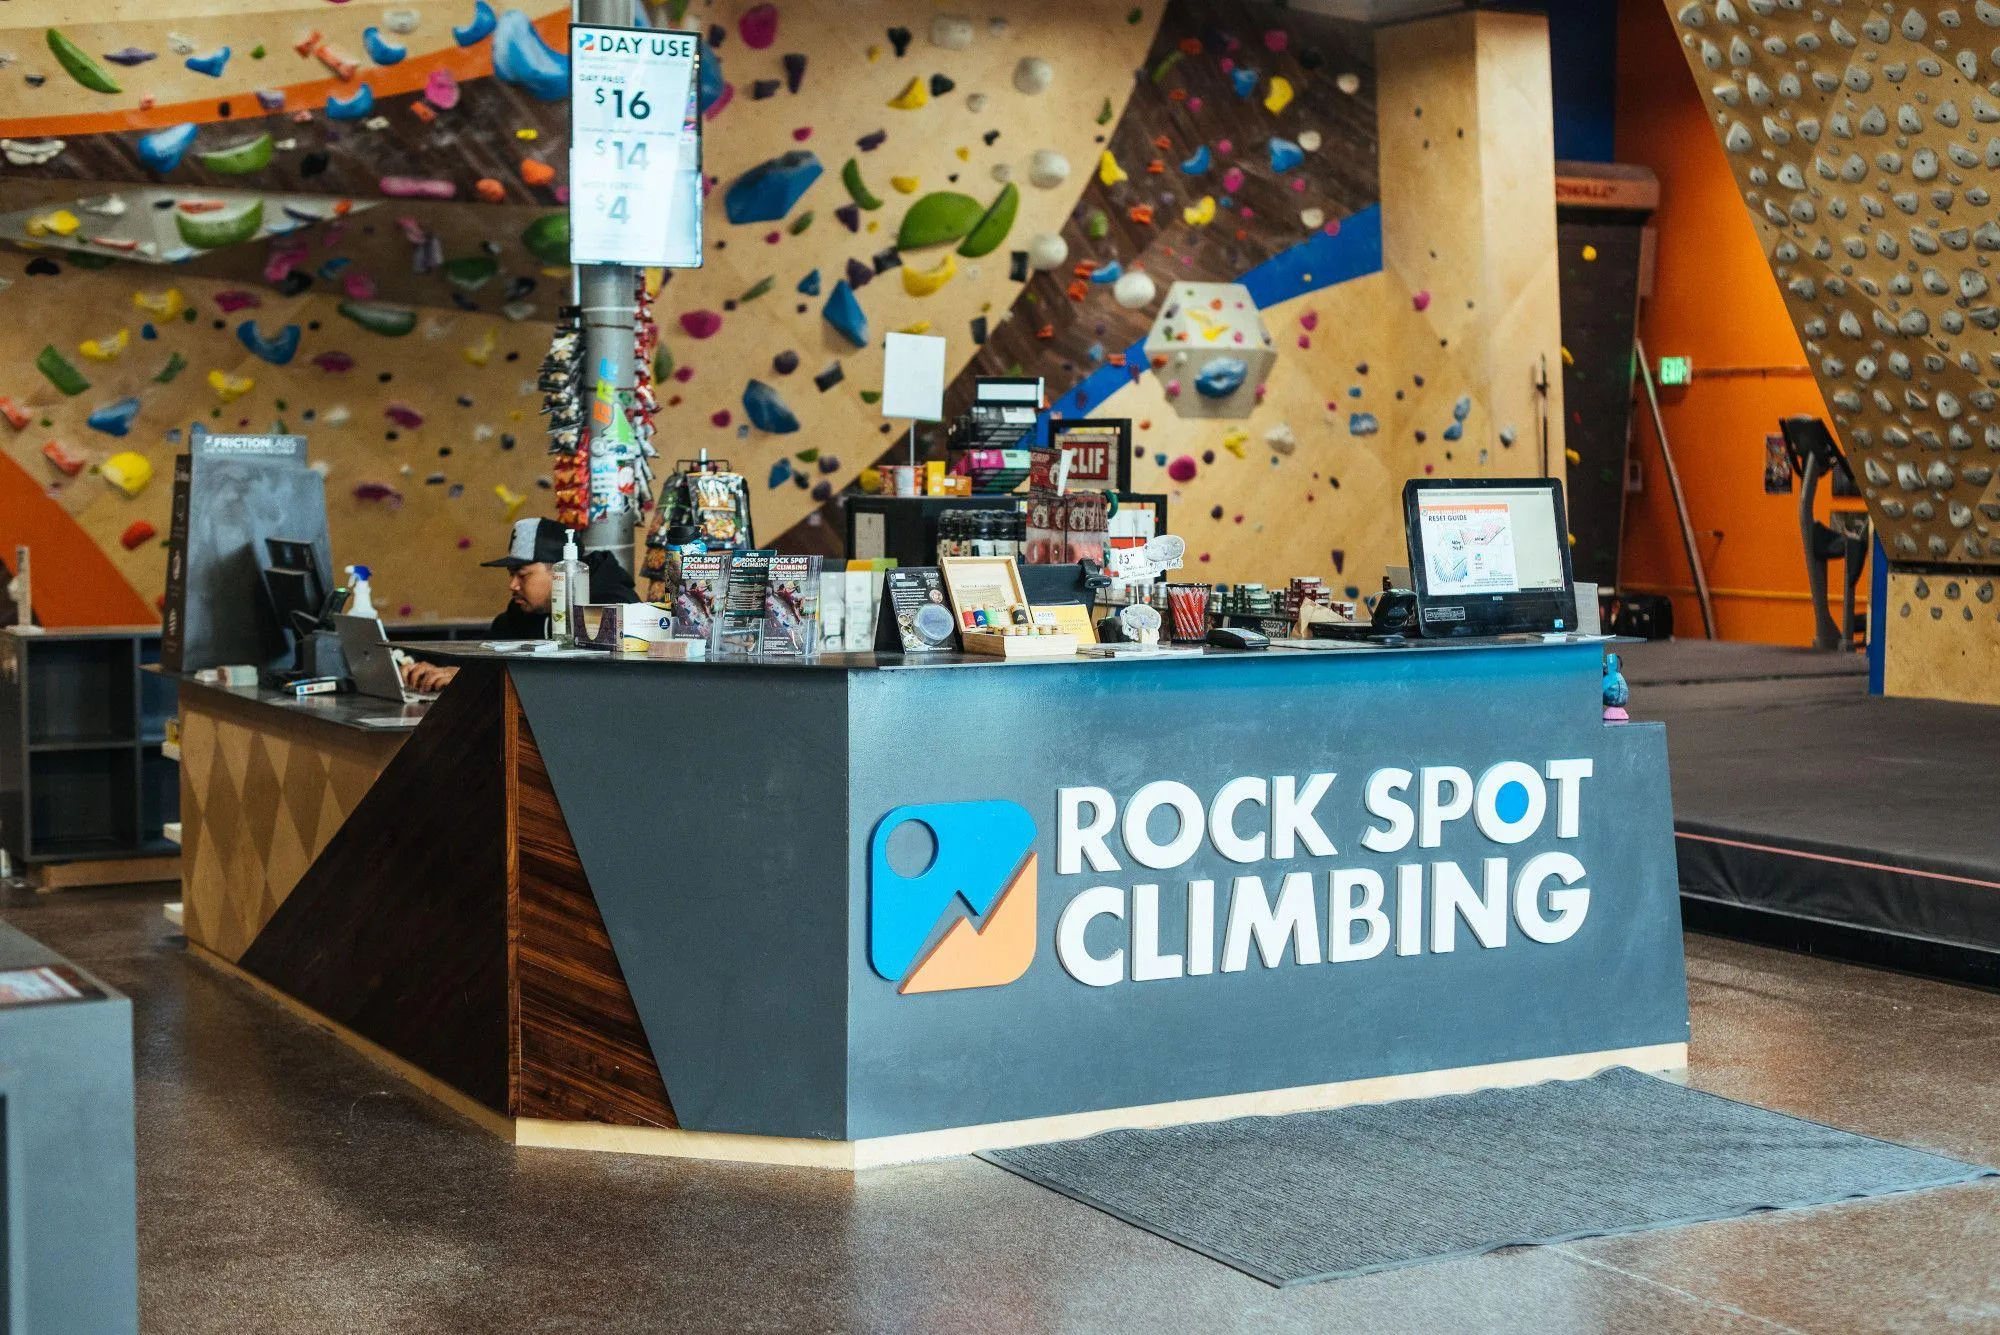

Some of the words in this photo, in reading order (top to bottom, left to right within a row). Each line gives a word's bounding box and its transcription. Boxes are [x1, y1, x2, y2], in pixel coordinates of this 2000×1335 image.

[600, 36, 643, 53] DAY
[651, 39, 690, 57] USE
[1447, 514, 1468, 522] GUIDE
[1057, 772, 1339, 875] ROCK
[1361, 758, 1593, 853] SPOT
[1056, 851, 1591, 987] CLIMBING
